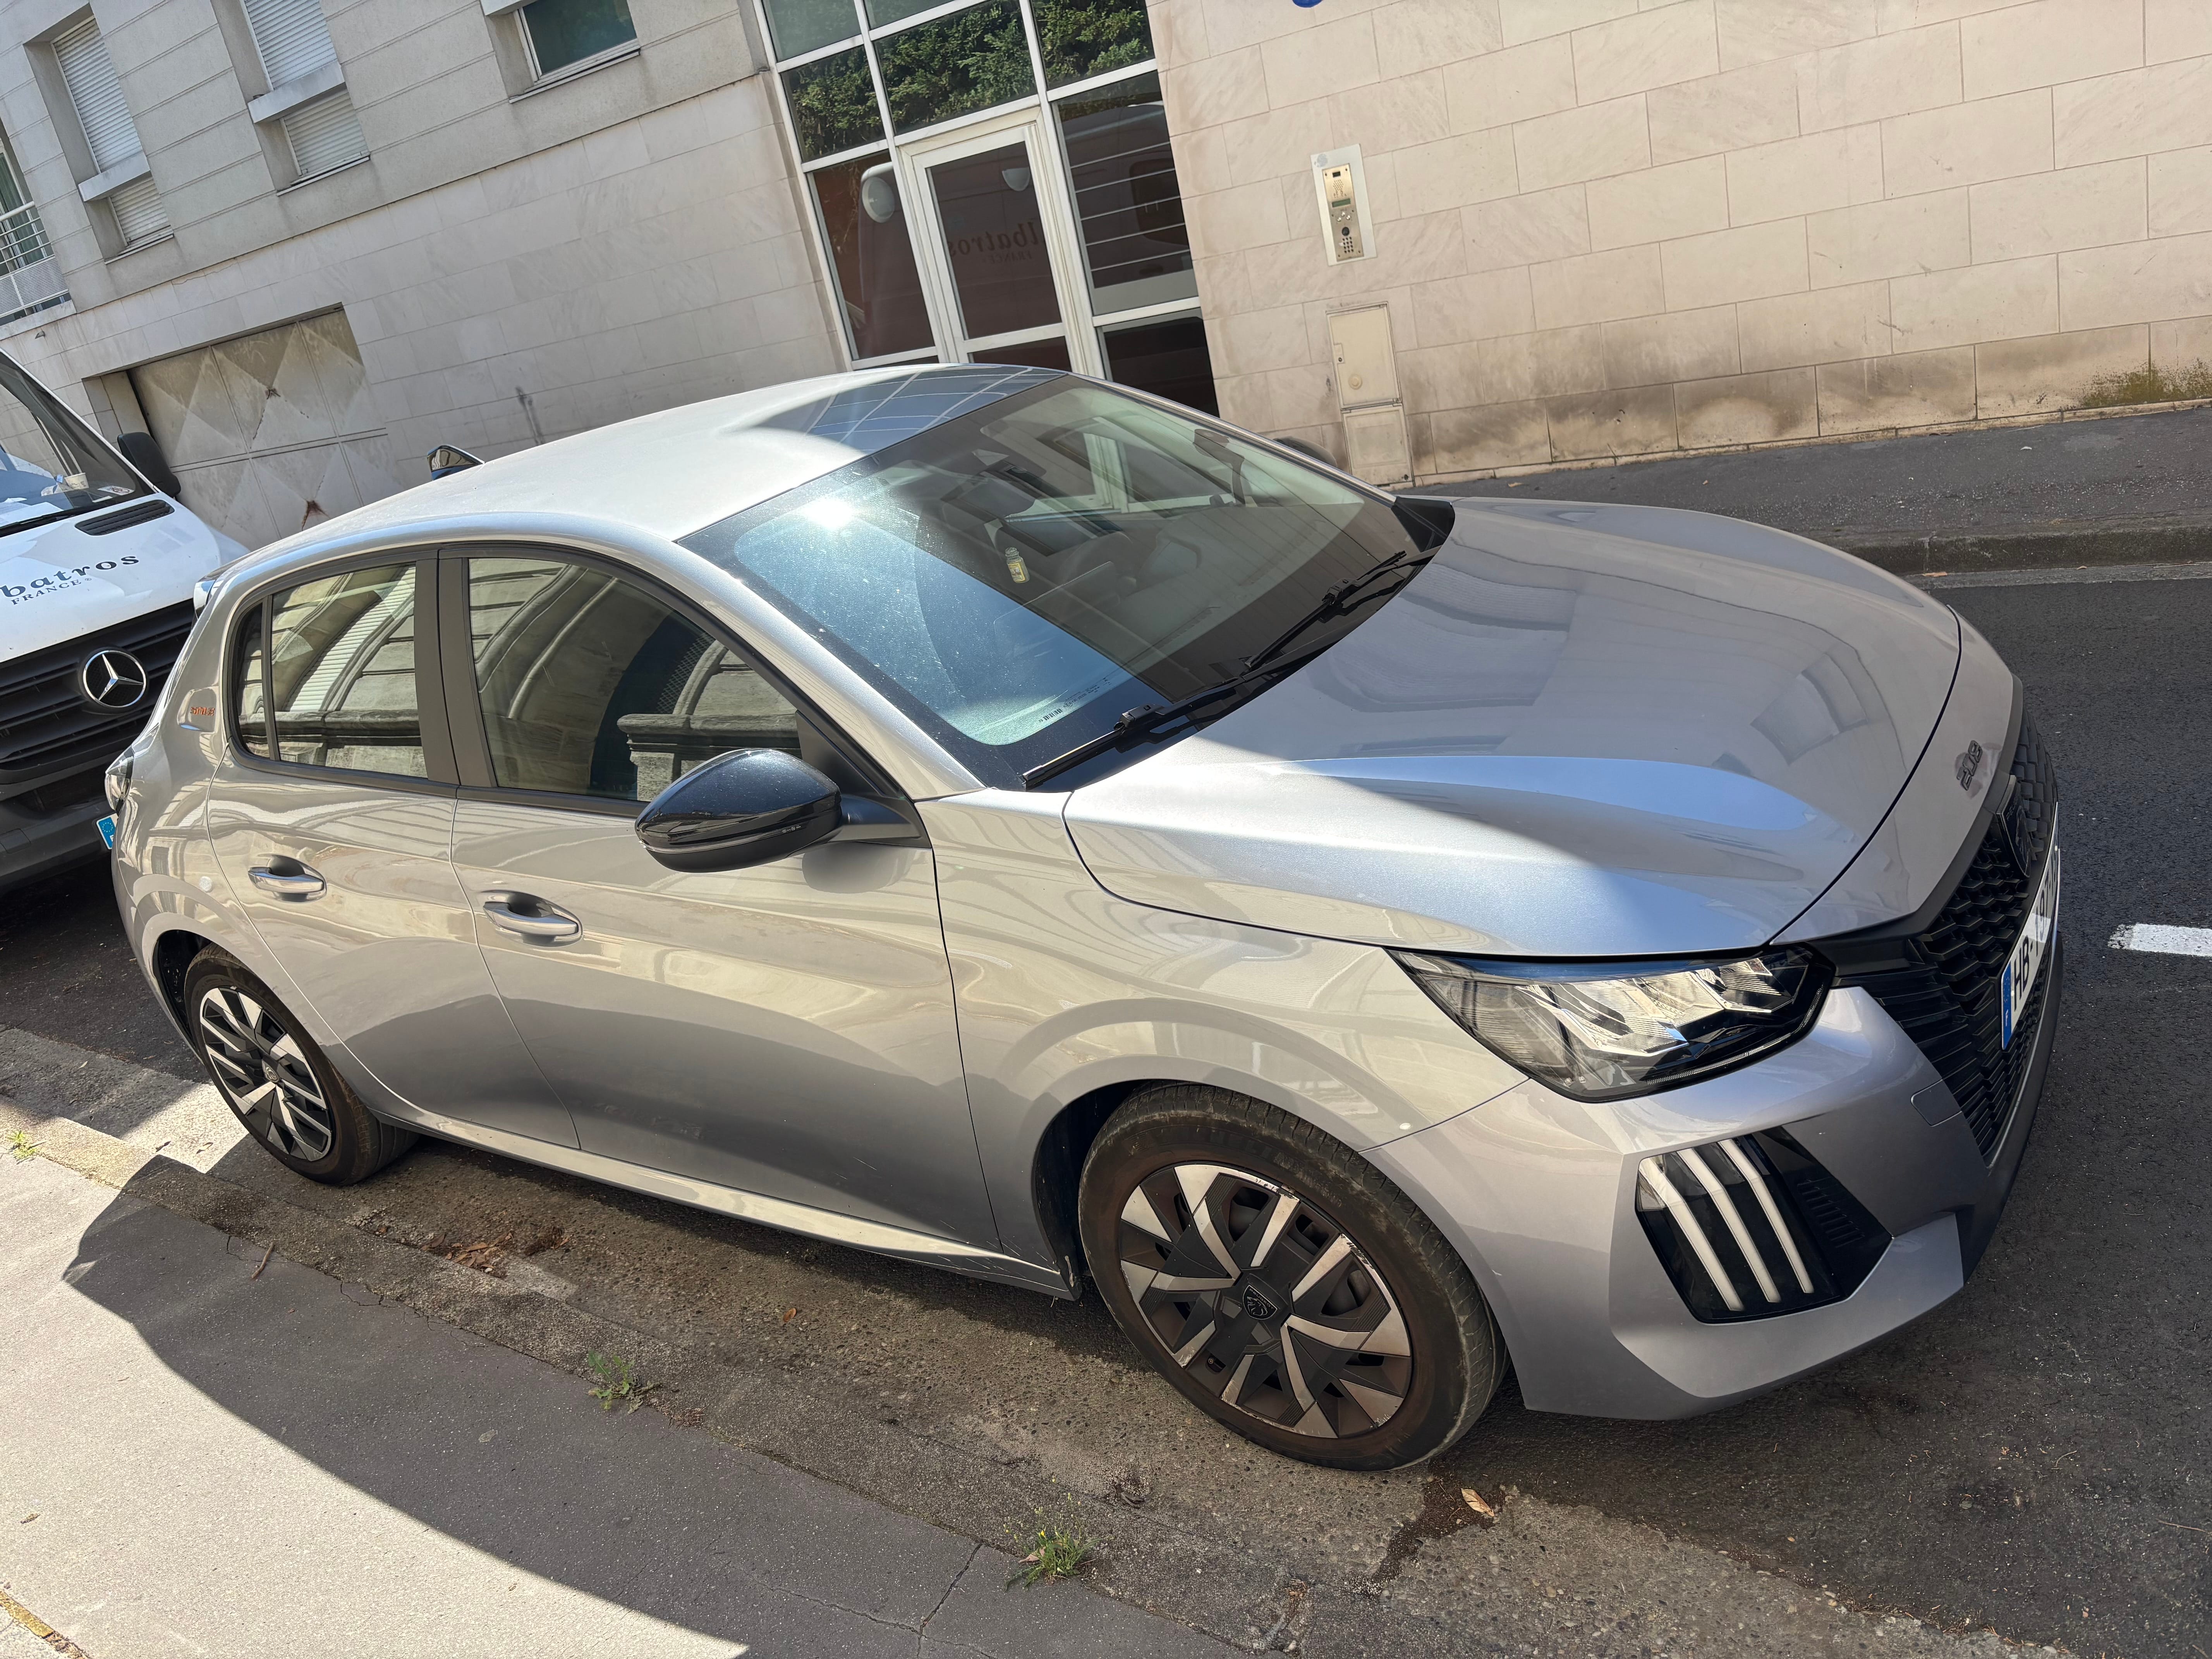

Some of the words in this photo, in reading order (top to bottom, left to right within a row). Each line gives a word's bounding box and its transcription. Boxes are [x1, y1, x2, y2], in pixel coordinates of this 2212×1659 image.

[11, 580, 81, 605] FRANCE
[191, 706, 215, 716] STYLE
[1956, 740, 1983, 791] 208
